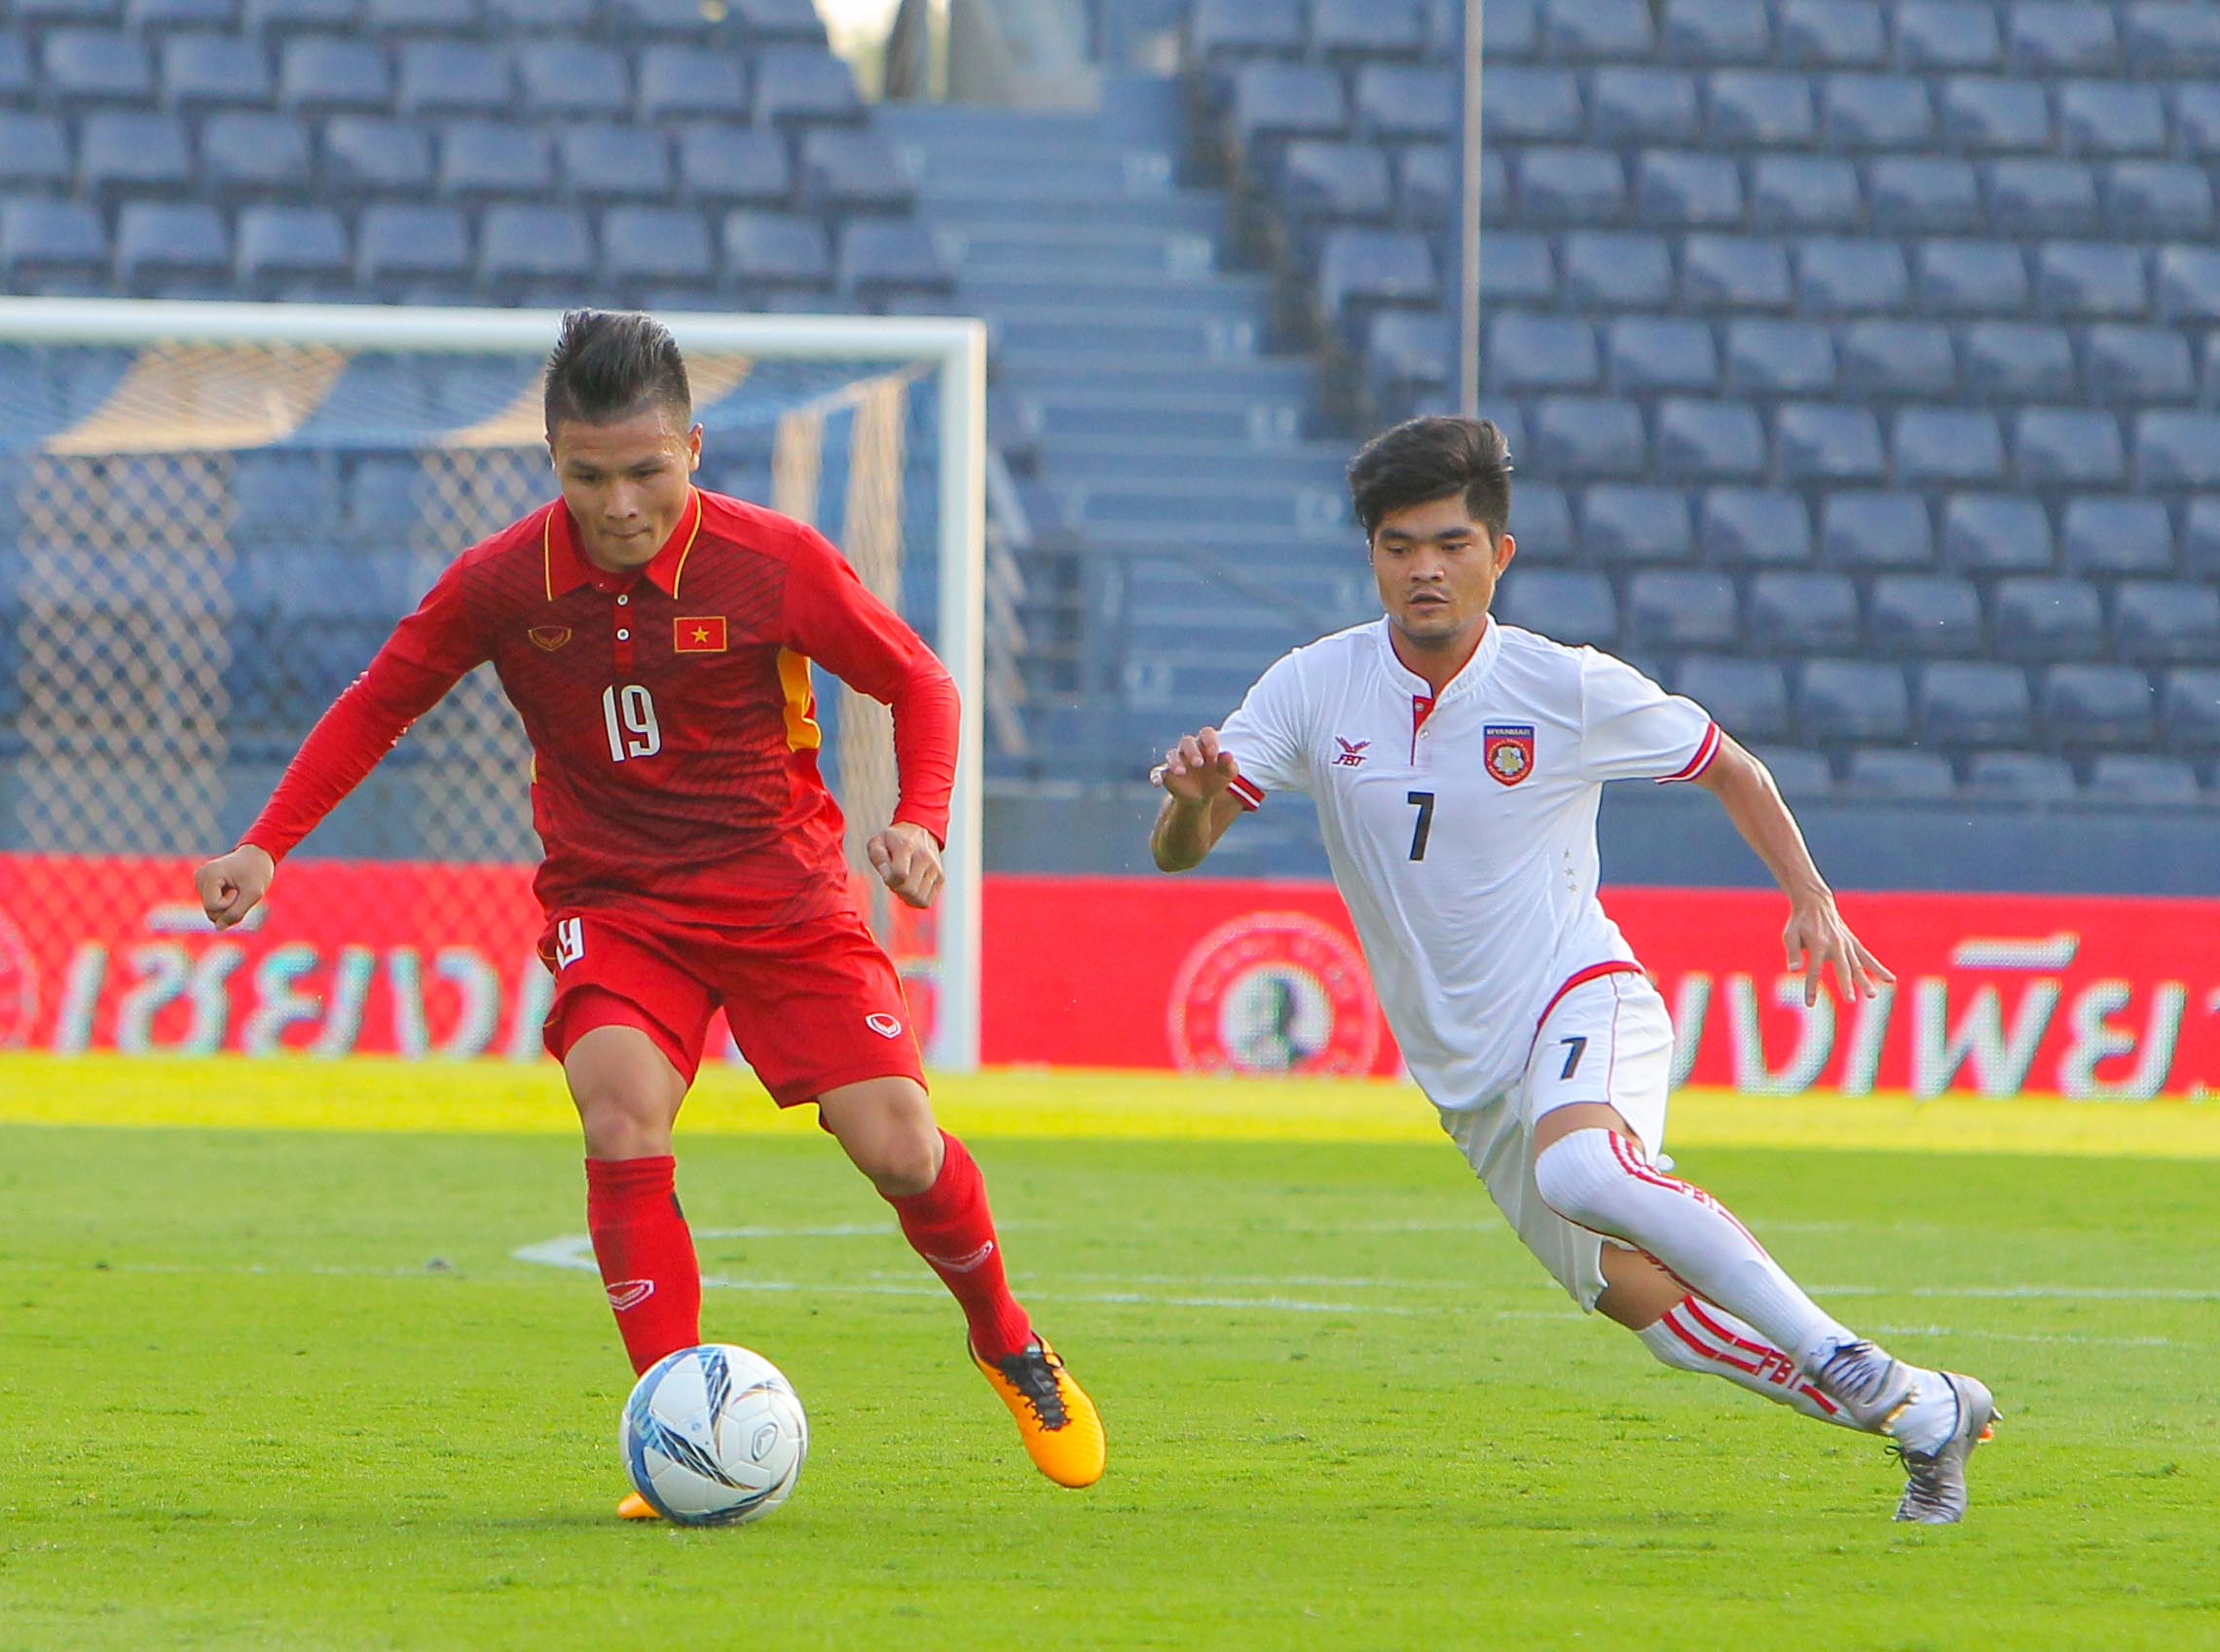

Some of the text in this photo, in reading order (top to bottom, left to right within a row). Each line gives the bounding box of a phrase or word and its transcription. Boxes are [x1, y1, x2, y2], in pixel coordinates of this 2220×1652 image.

[603, 684, 661, 762] 19
[1331, 753, 1368, 768] FBT
[1407, 791, 1434, 862] 7
[1560, 1037, 1587, 1081] 7
